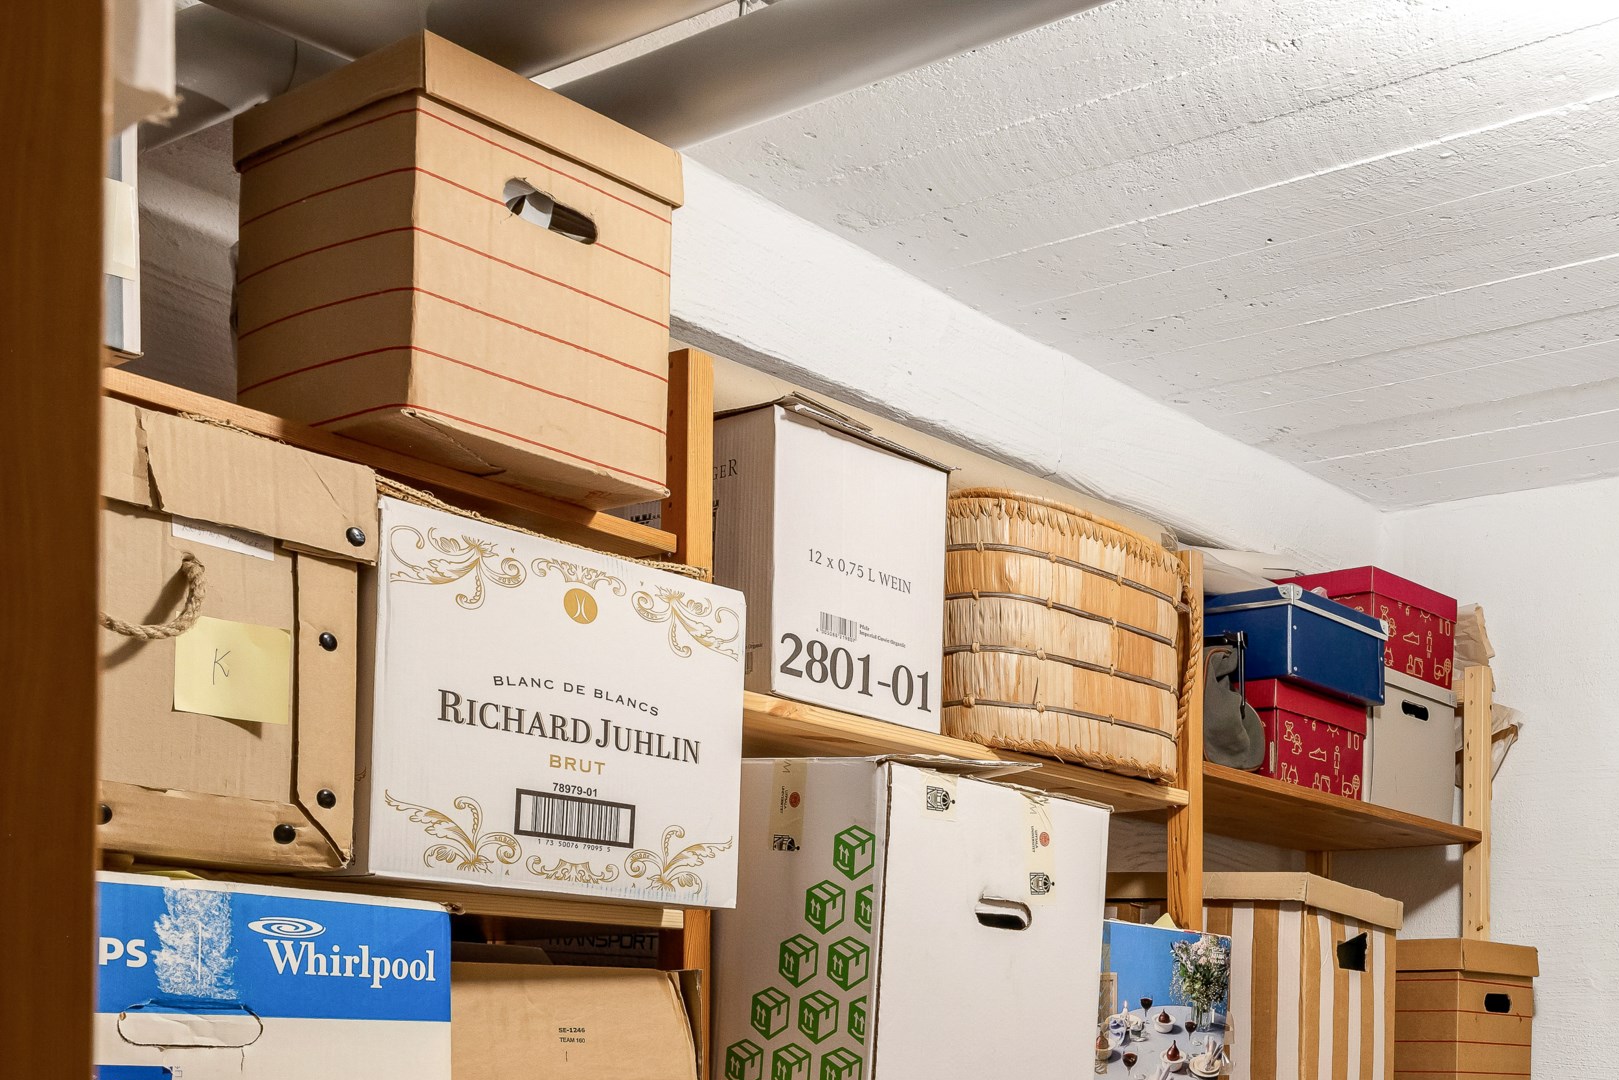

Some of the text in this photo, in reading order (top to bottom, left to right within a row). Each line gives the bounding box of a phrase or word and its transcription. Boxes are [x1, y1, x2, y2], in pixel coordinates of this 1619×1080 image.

[808, 548, 911, 594] 12 x 0,75 L WEIN
[212, 648, 231, 685] K
[780, 632, 931, 713] 2801-01
[493, 675, 659, 716] BLANC DE BLANCS
[438, 689, 701, 765] RICHARD JUHLIN
[549, 754, 606, 775] BRUT
[552, 782, 598, 797] 78979-01
[558, 841, 579, 850] 50076
[263, 939, 437, 988] Whirlpool
